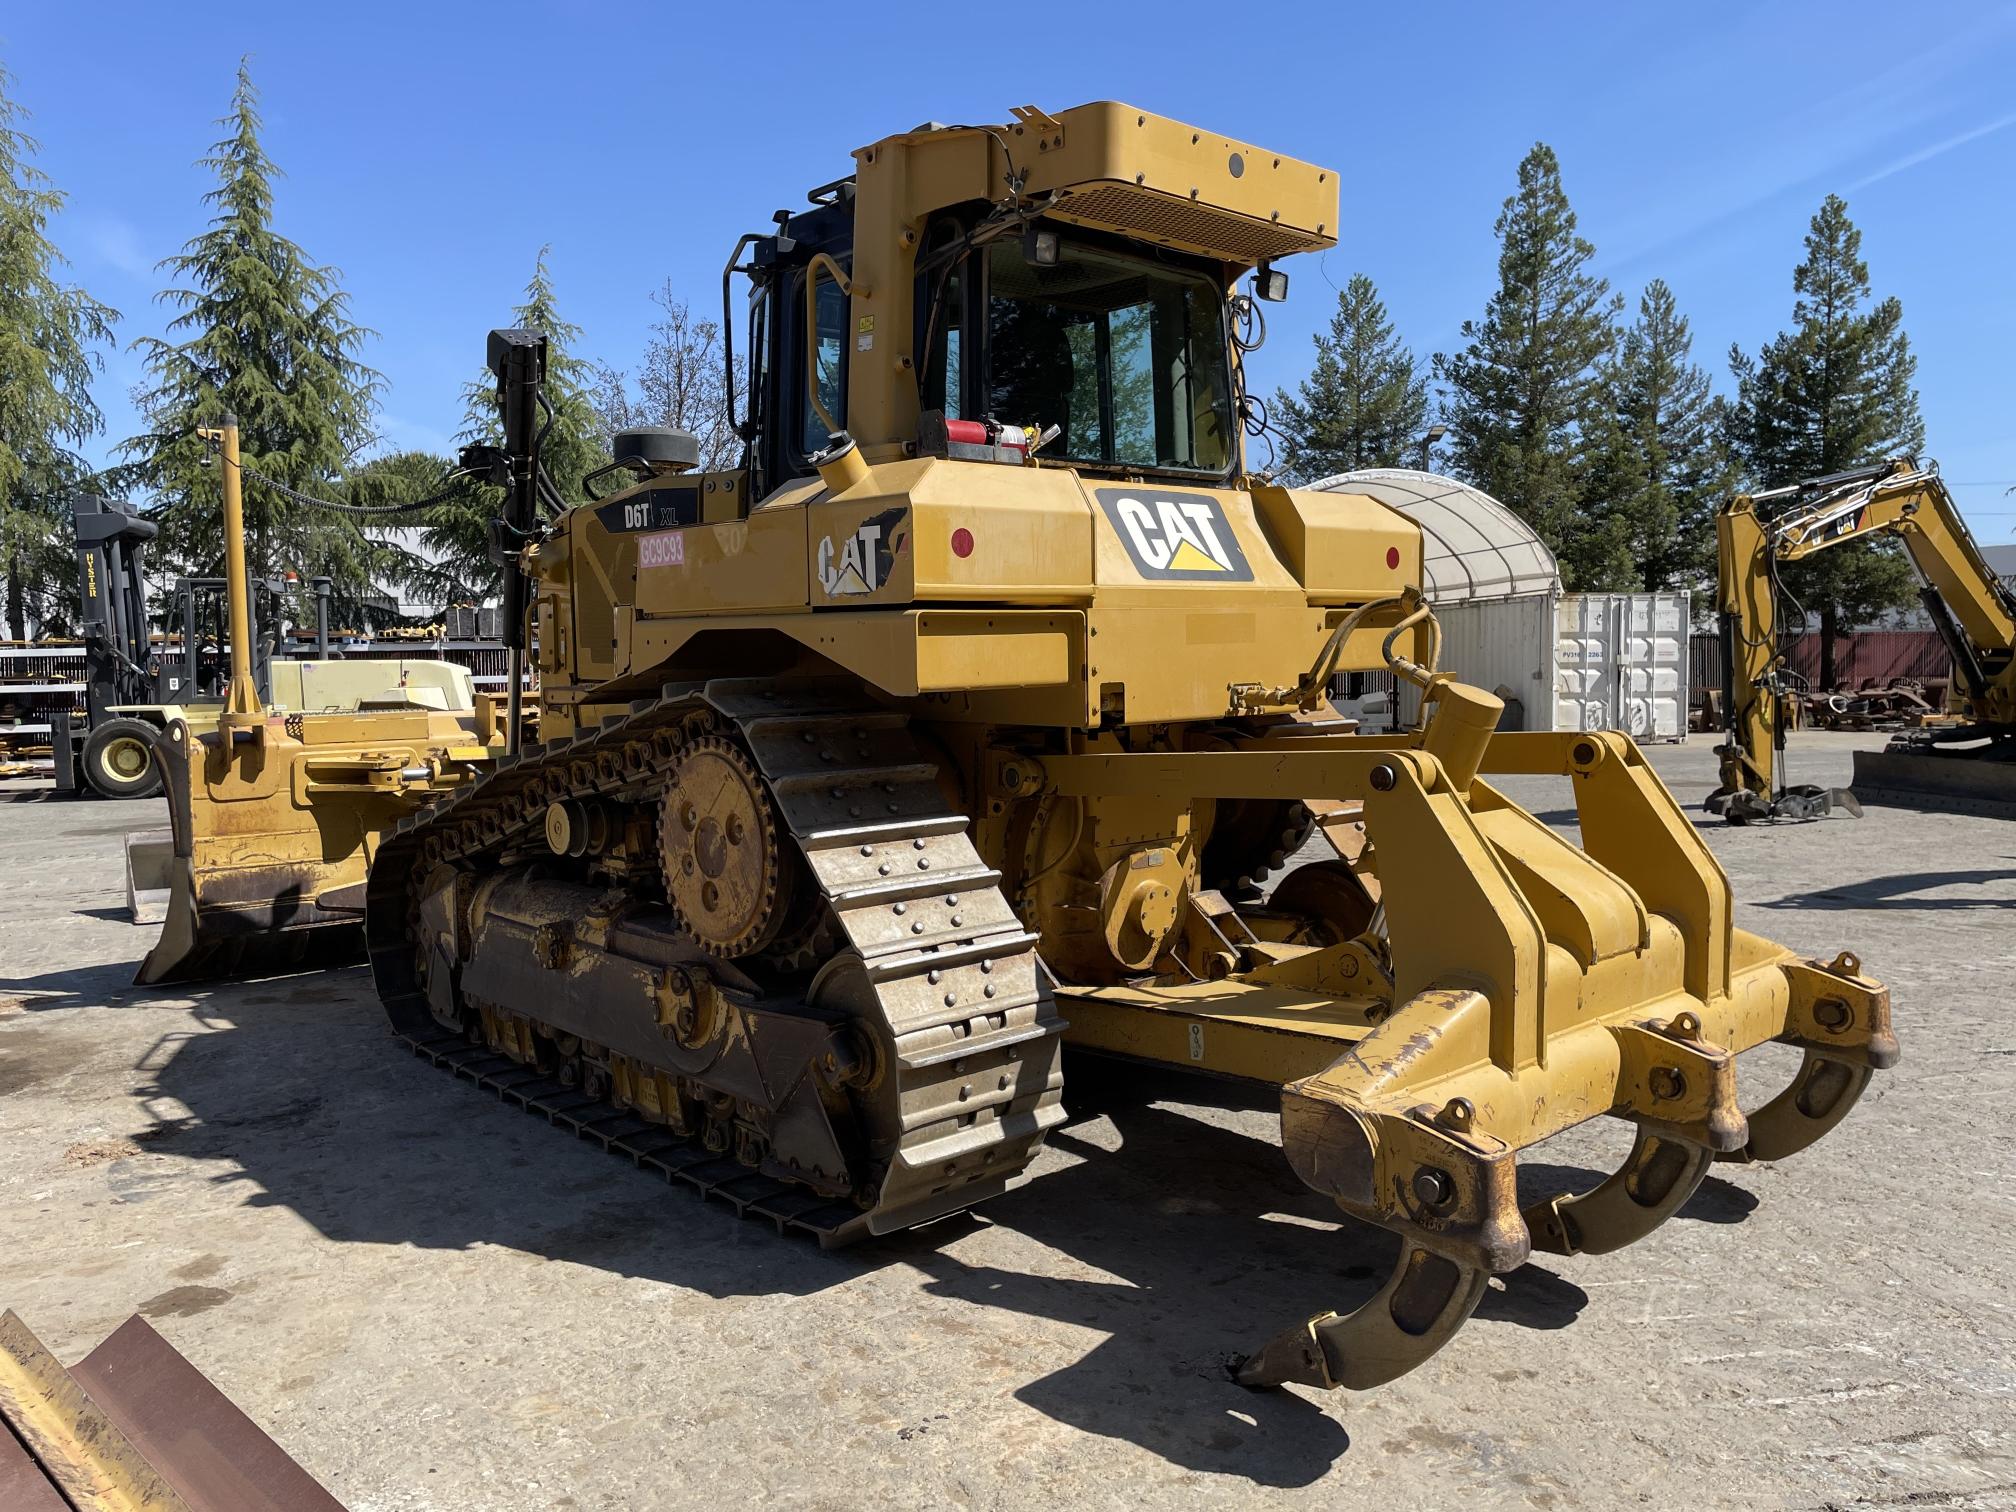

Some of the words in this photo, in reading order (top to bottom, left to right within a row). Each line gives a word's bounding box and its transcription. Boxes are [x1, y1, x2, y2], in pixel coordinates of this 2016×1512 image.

[624, 502, 649, 529] D6T
[660, 507, 679, 526] XL
[1117, 498, 1234, 571] CAT
[1836, 513, 1856, 535] CAT
[86, 553, 97, 598] HYSTER
[818, 525, 881, 594] CAT
